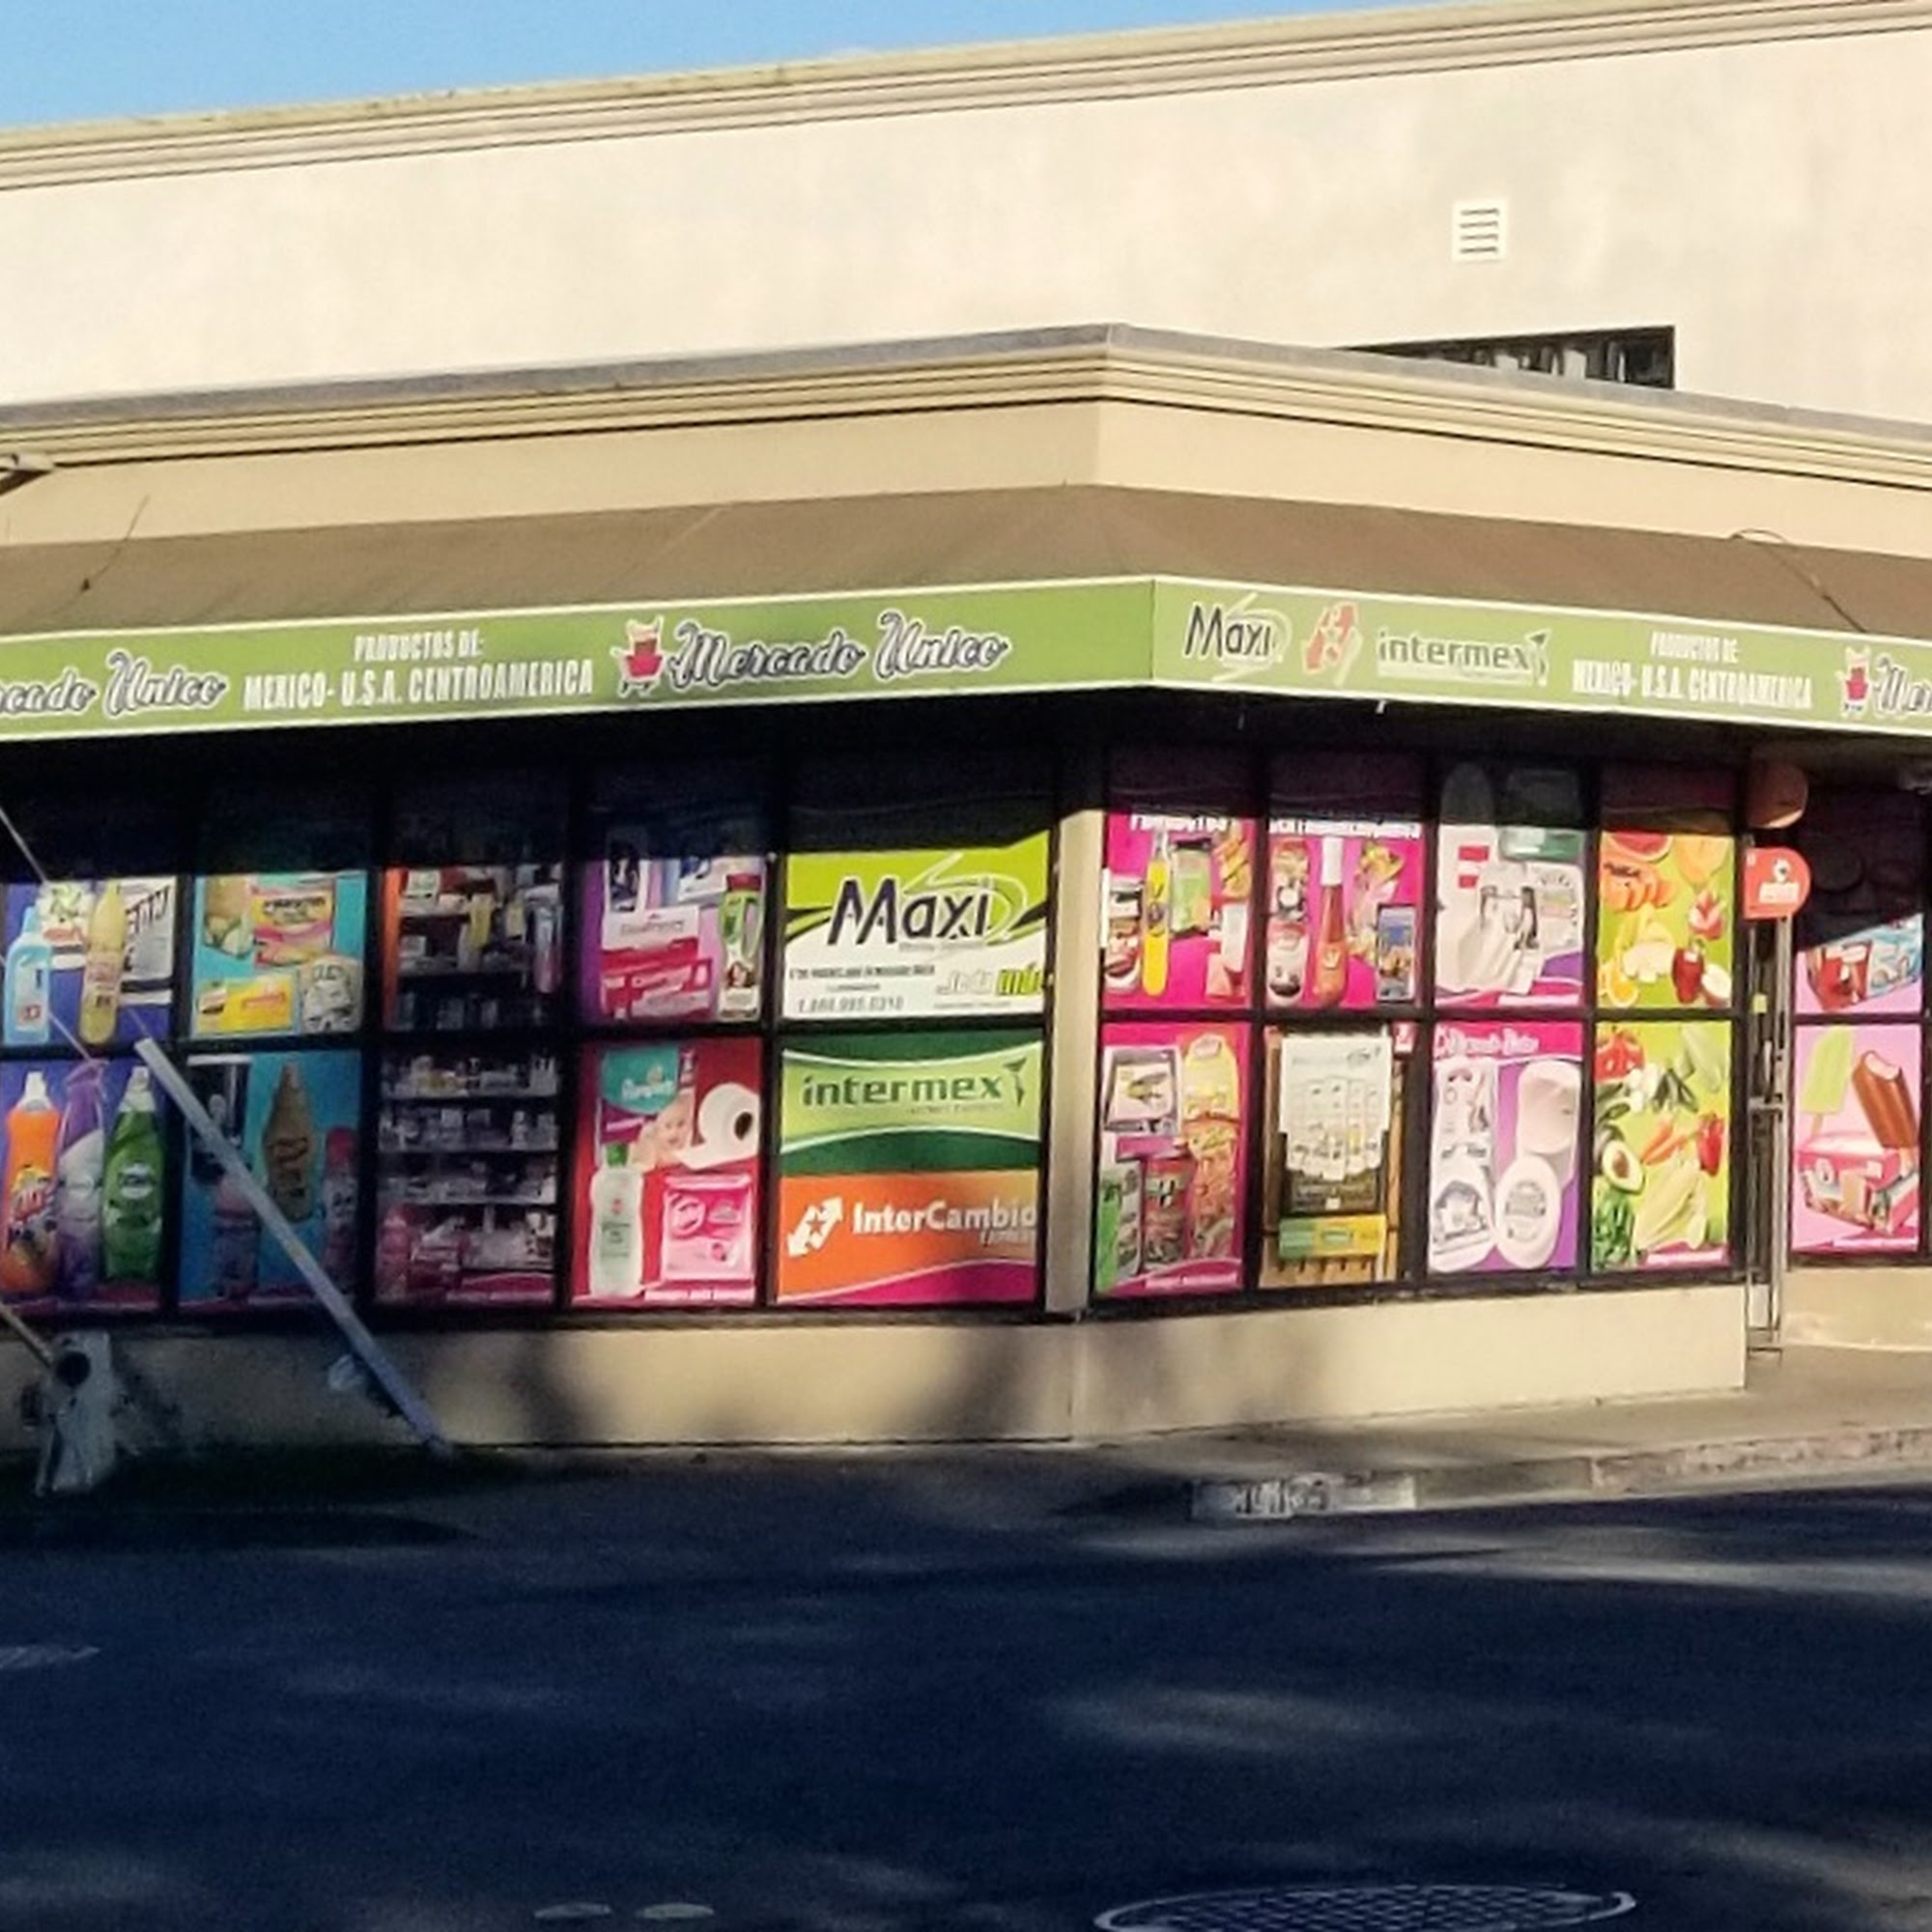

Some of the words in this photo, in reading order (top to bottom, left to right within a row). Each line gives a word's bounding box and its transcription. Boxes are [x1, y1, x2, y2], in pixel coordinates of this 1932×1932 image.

[354, 631, 453, 663] PRODUCTOS
[668, 620, 867, 691] Mercado
[875, 609, 1010, 679] Unico
[1183, 603, 1275, 659] Maxi
[1378, 631, 1530, 670] intermex
[0, 667, 98, 716] cado
[104, 648, 227, 718] Unico
[409, 659, 593, 705] CENTROAMERICA
[827, 877, 991, 946] Maxi
[803, 1075, 1003, 1107] intermex
